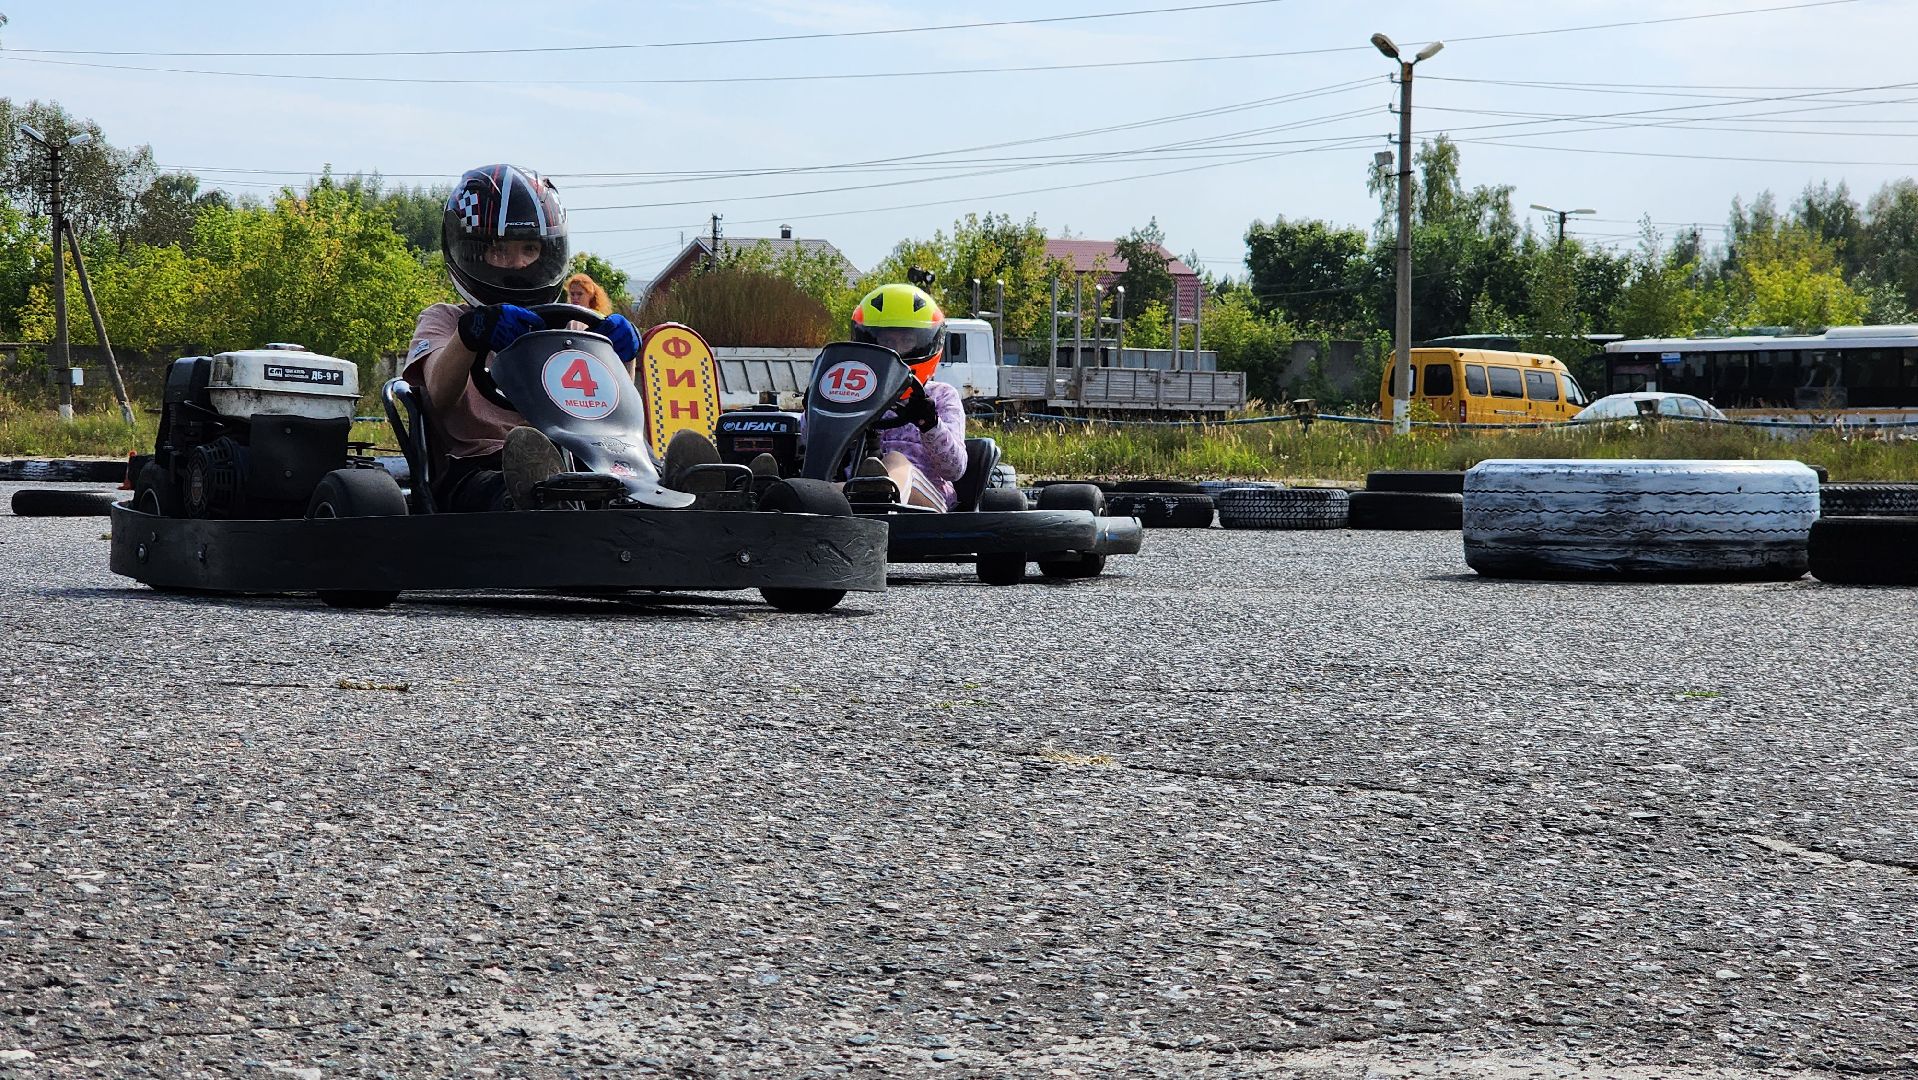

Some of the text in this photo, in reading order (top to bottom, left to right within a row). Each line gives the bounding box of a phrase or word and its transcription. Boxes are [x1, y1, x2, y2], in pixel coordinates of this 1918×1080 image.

[311, 370, 331, 381] ДБ-9
[561, 359, 598, 397] 4
[662, 336, 700, 420] ФИН
[828, 367, 868, 390] 15
[565, 399, 608, 409] МЕЩЕРА
[735, 421, 776, 431] LIFAN
